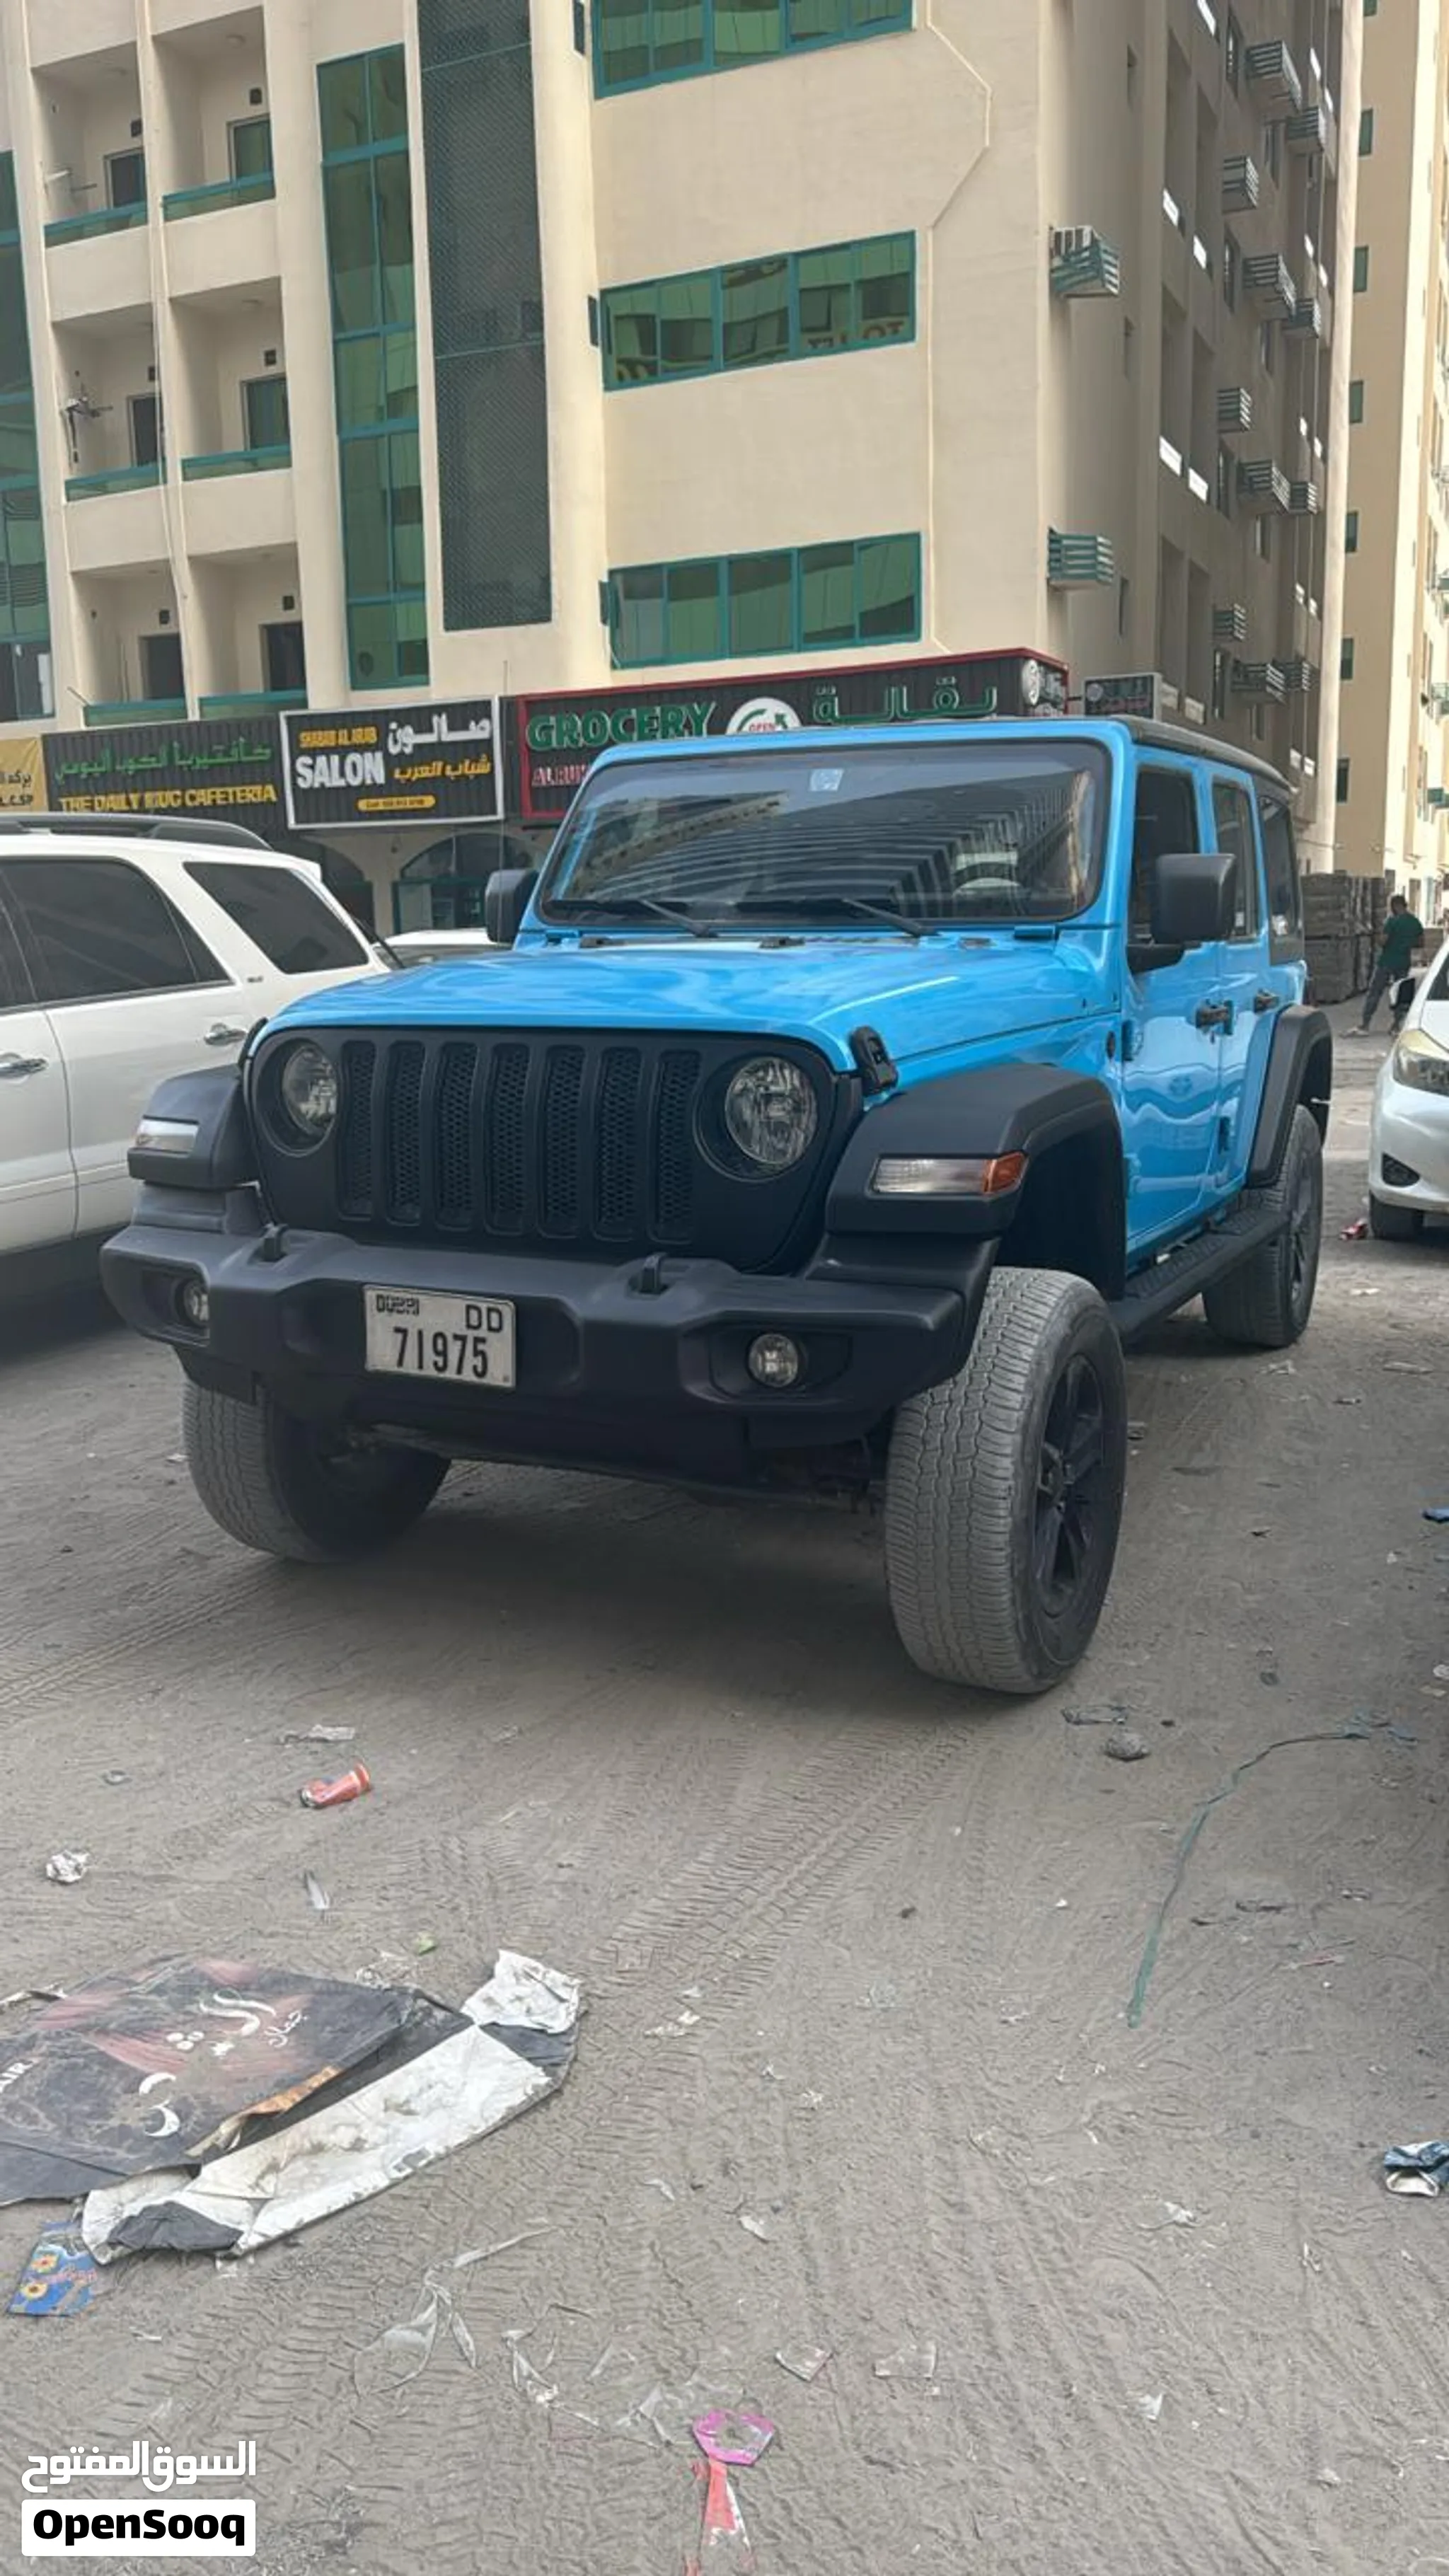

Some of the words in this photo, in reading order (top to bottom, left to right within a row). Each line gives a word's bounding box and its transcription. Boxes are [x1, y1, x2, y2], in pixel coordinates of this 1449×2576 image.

[388, 712, 491, 754] صالون
[527, 701, 716, 751] GROCERY
[296, 751, 386, 788] SALON
[393, 761, 443, 783] العرب
[445, 753, 491, 780] شباب
[59, 795, 91, 812] THE
[94, 792, 141, 812] DAILY
[185, 783, 278, 807] CAFETERIA
[465, 1305, 502, 1332] DD
[393, 1327, 488, 1378] 71975
